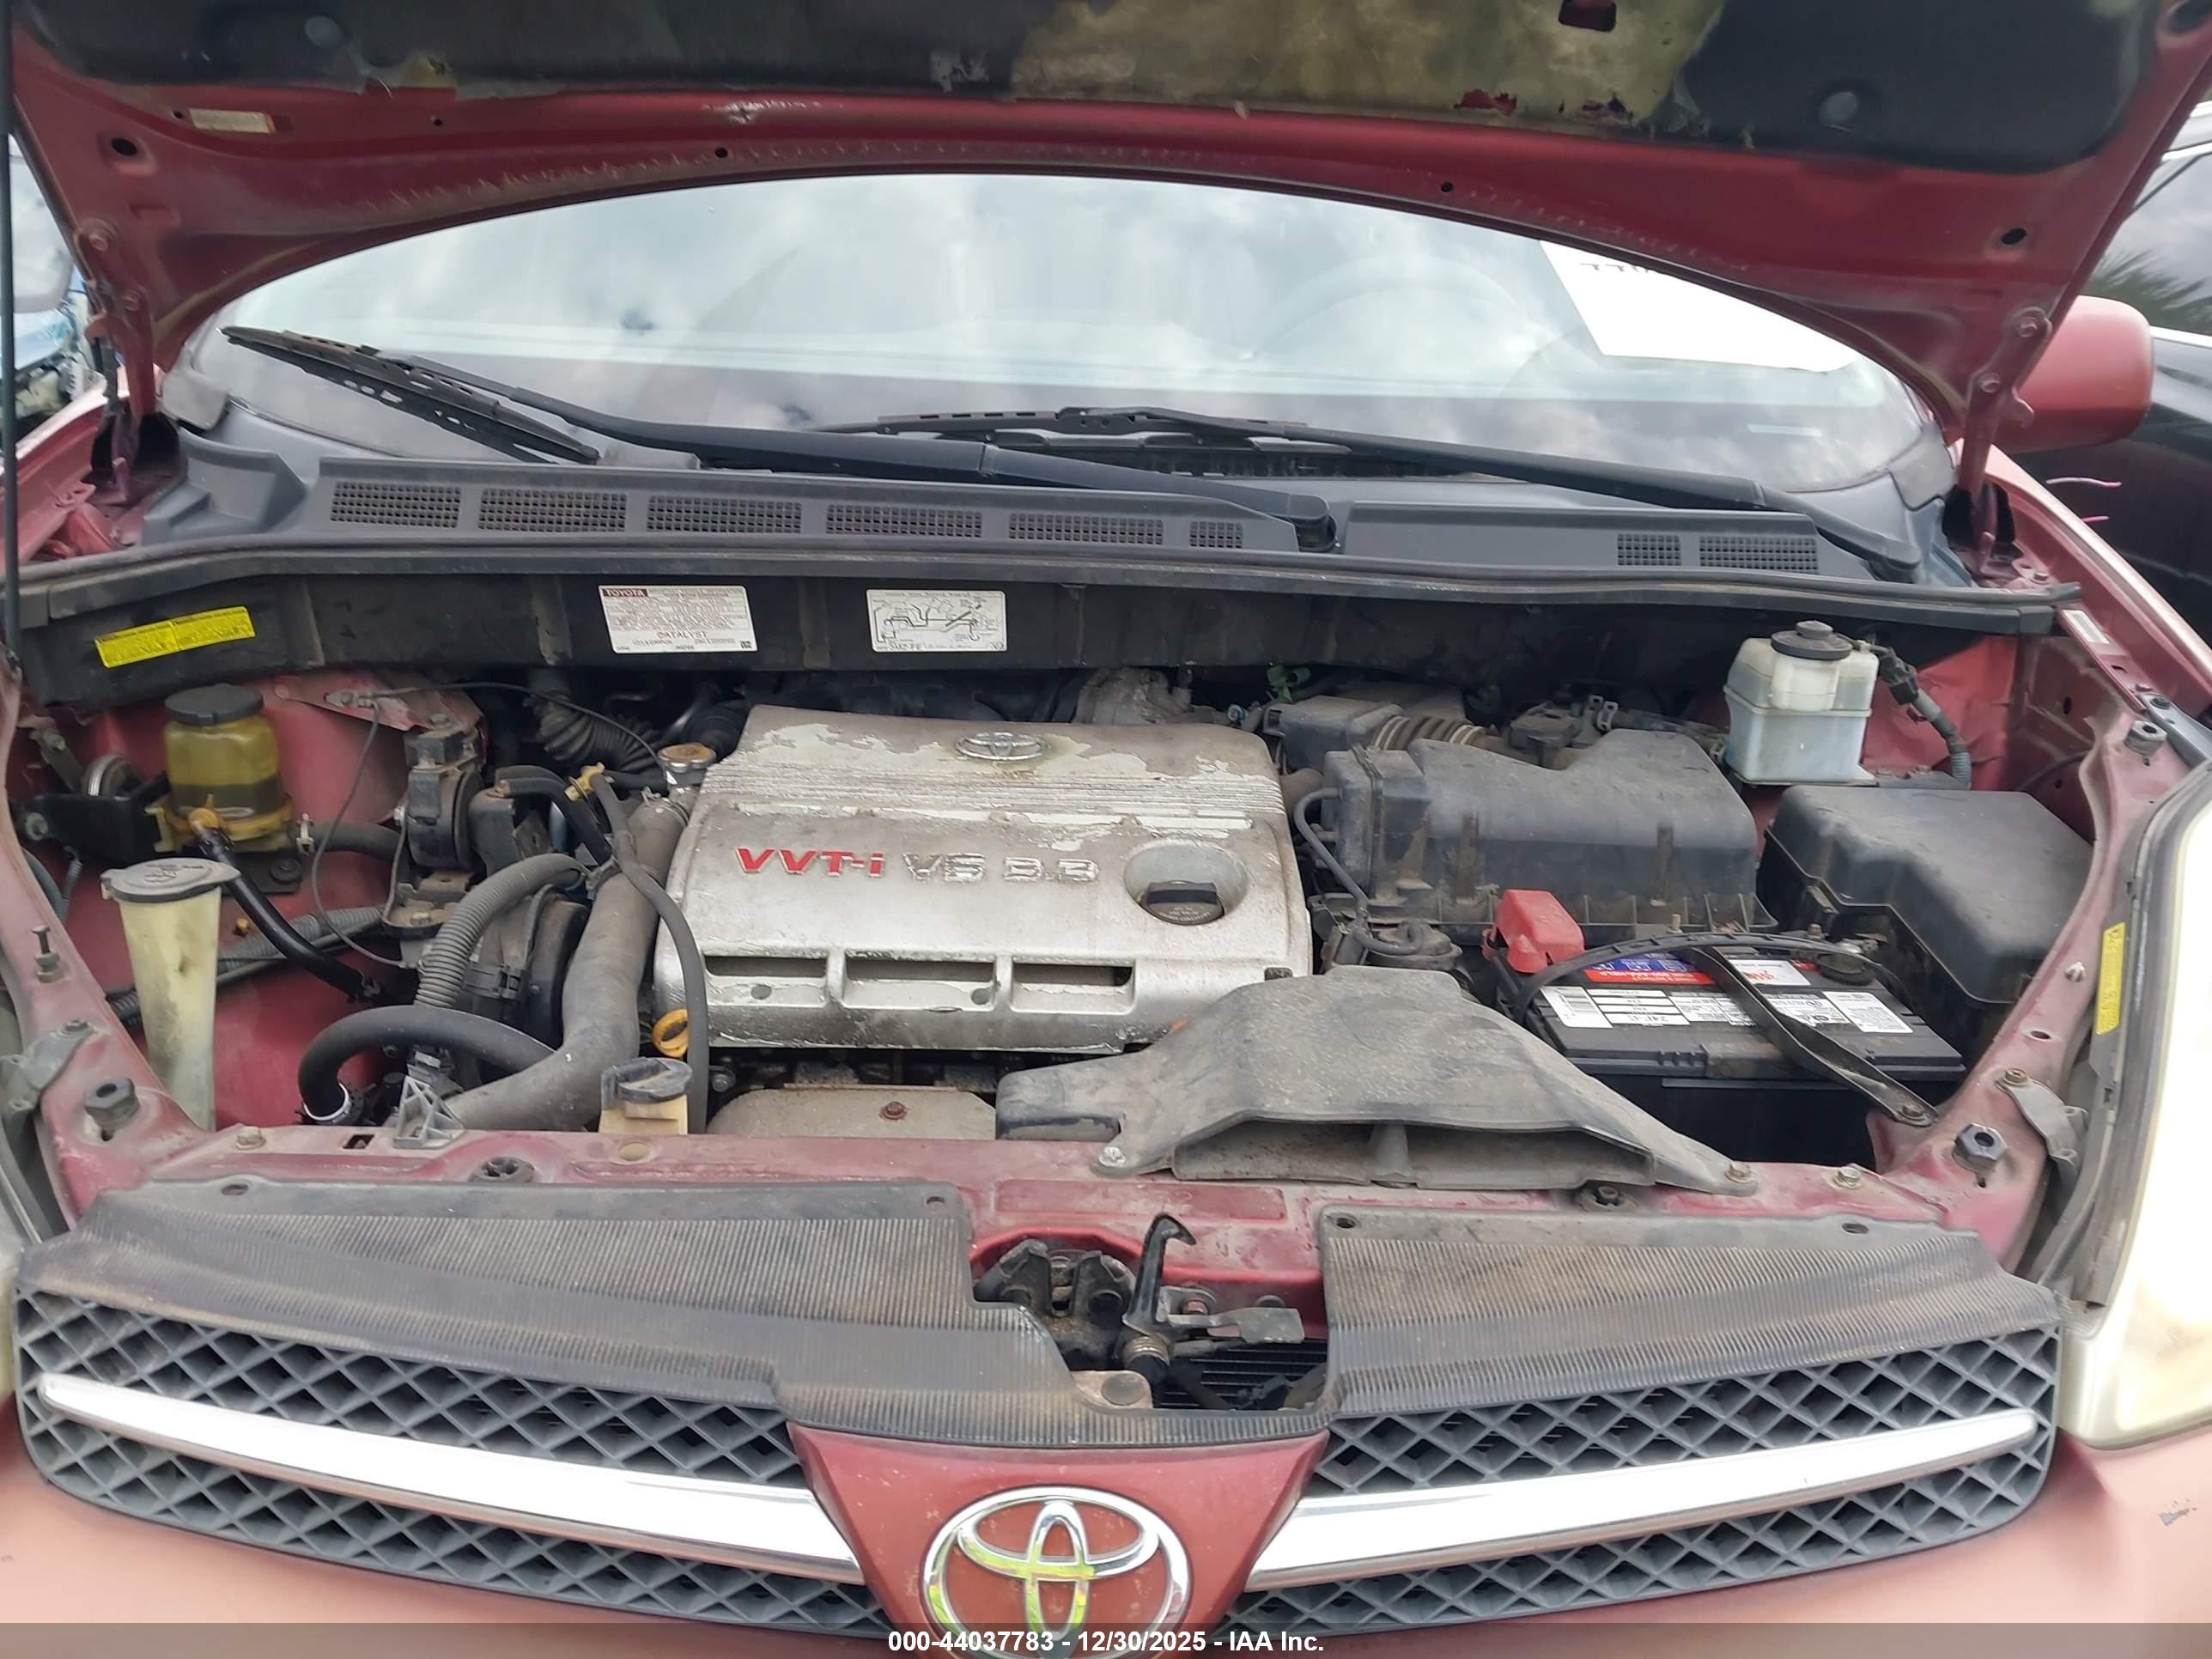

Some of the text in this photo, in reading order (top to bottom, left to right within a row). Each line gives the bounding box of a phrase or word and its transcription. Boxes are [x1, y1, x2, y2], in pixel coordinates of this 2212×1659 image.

[605, 588, 645, 598] TOYOTA
[657, 631, 708, 640] CATALYST
[735, 846, 1102, 884] VVT-i V6 3.3
